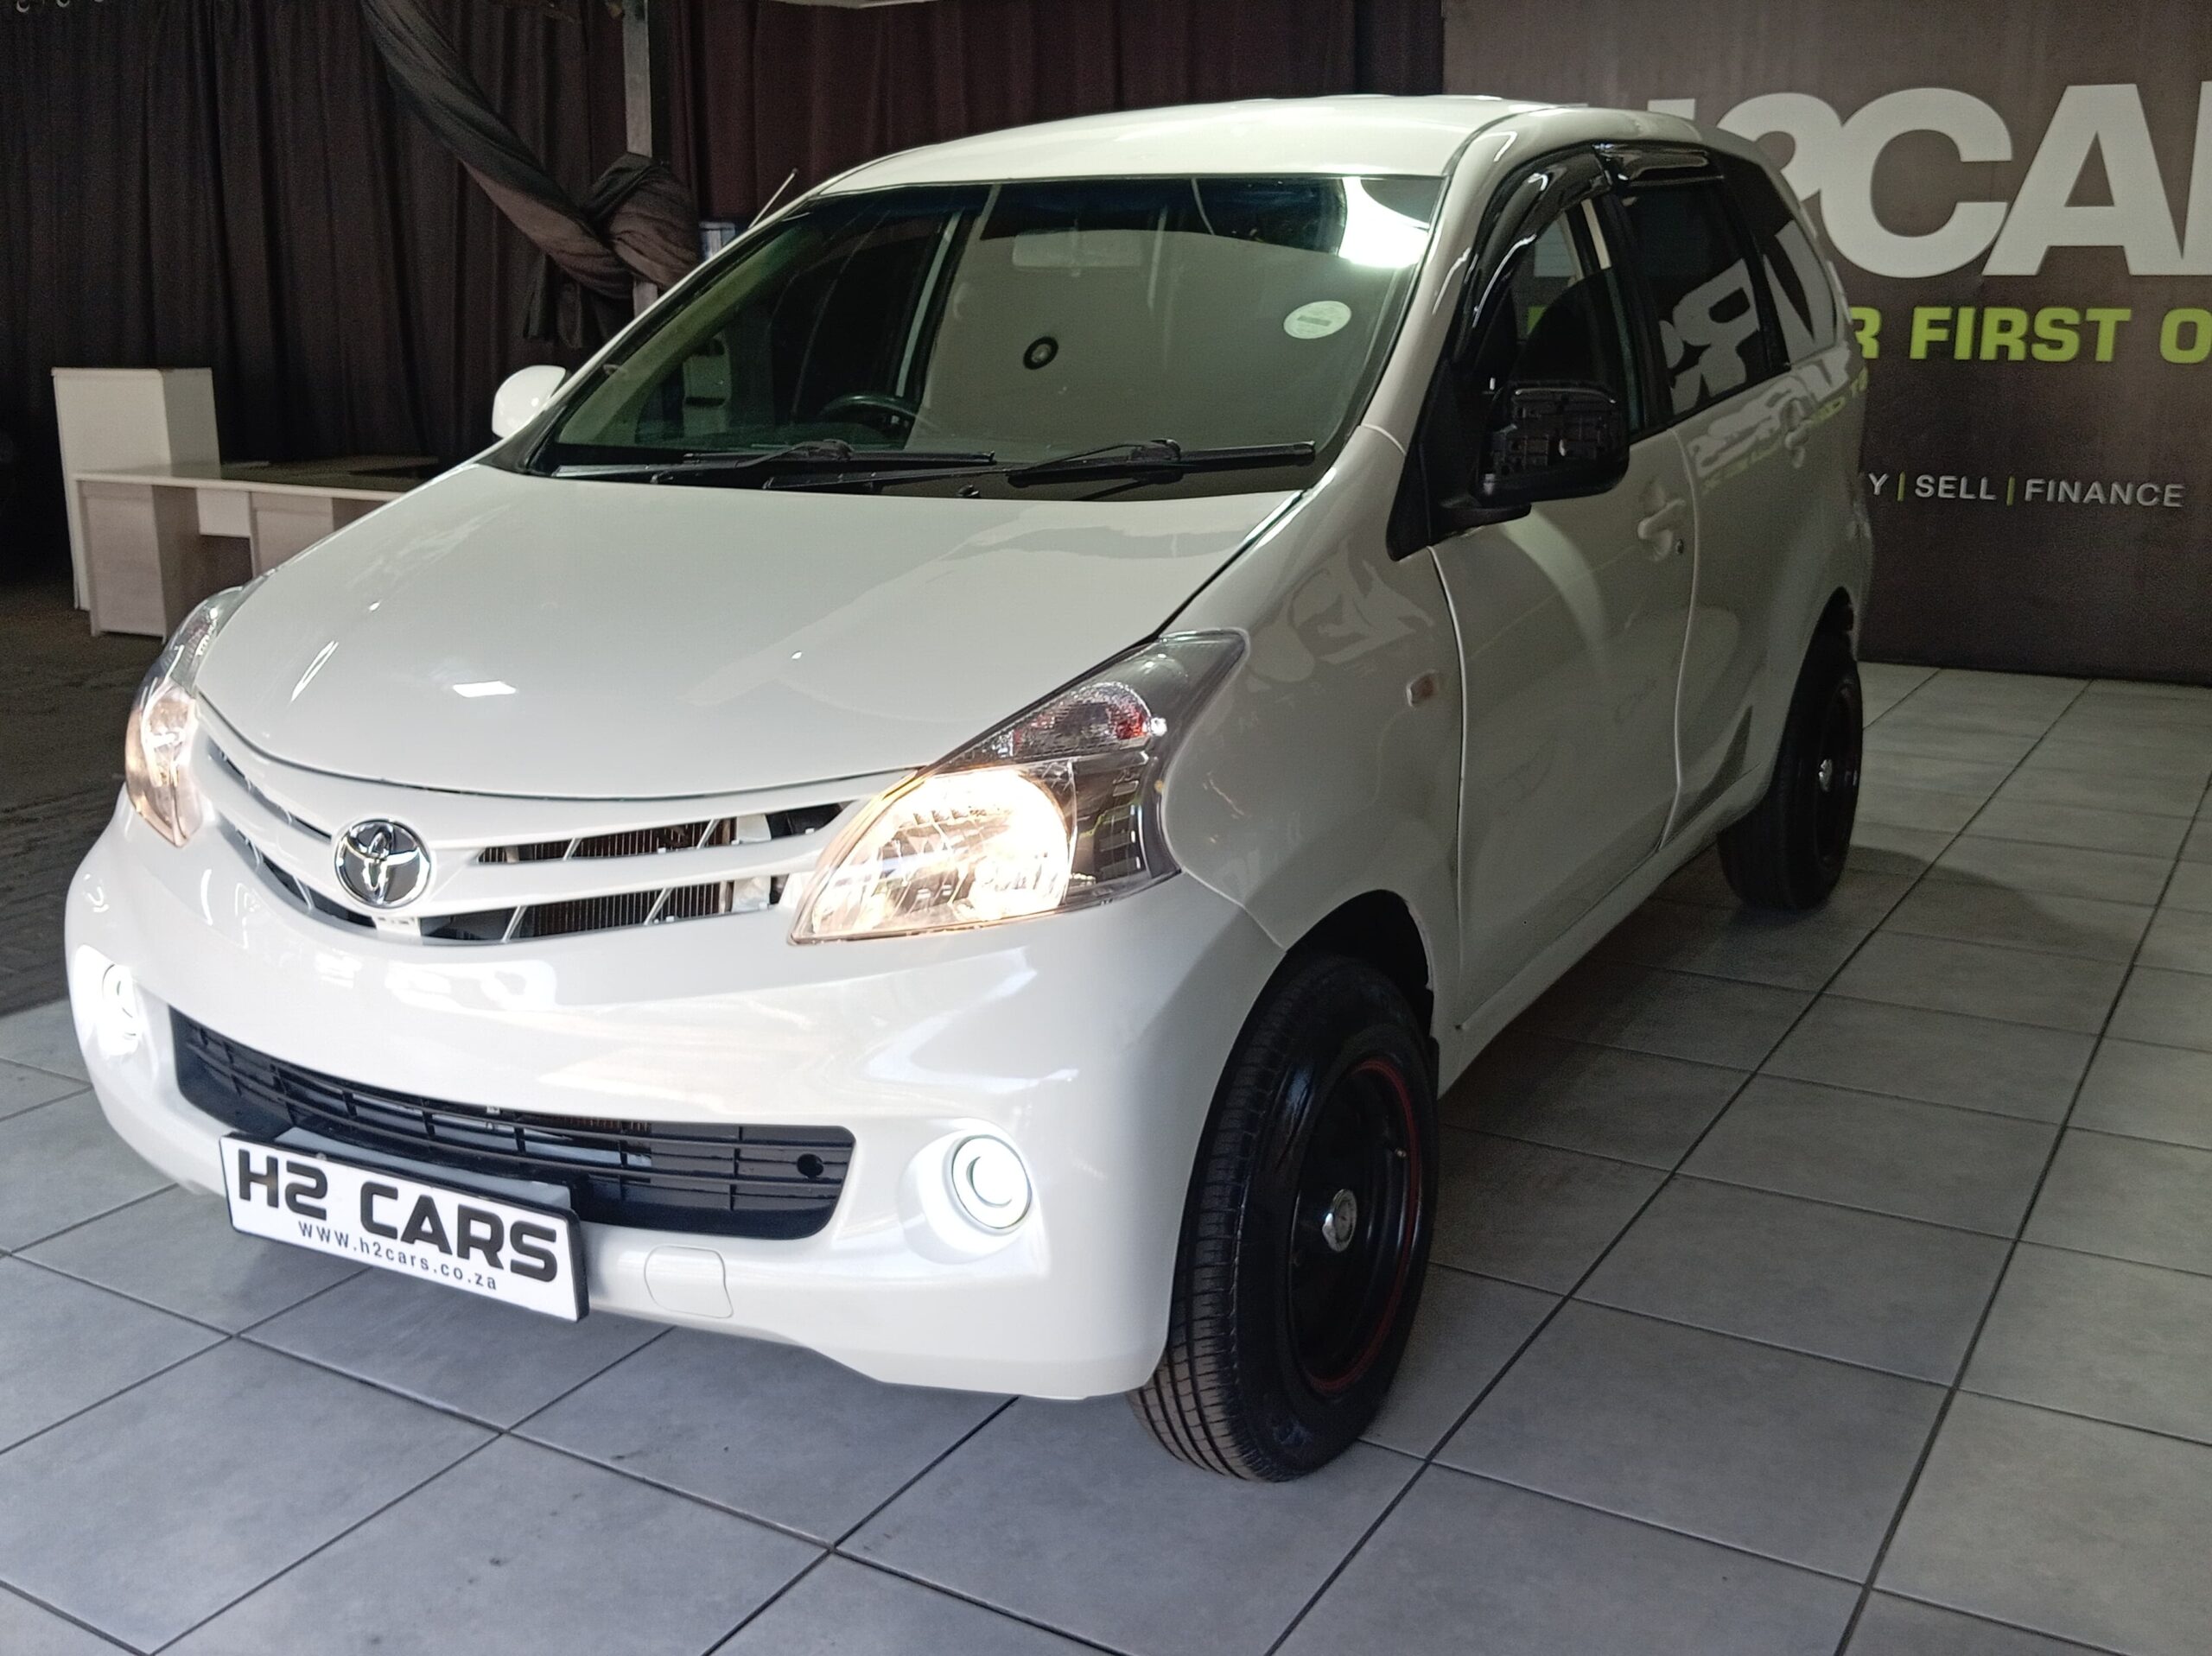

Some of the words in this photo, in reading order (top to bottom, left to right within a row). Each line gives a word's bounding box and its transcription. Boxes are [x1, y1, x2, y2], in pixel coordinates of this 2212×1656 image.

[1909, 306, 2132, 363] FIRST
[1914, 474, 1997, 501] SELL
[2024, 479, 2185, 508] FINANCE
[238, 1148, 328, 1221] H2
[359, 1180, 558, 1283] CARS
[298, 1220, 498, 1291] www.h2cars.co.za
